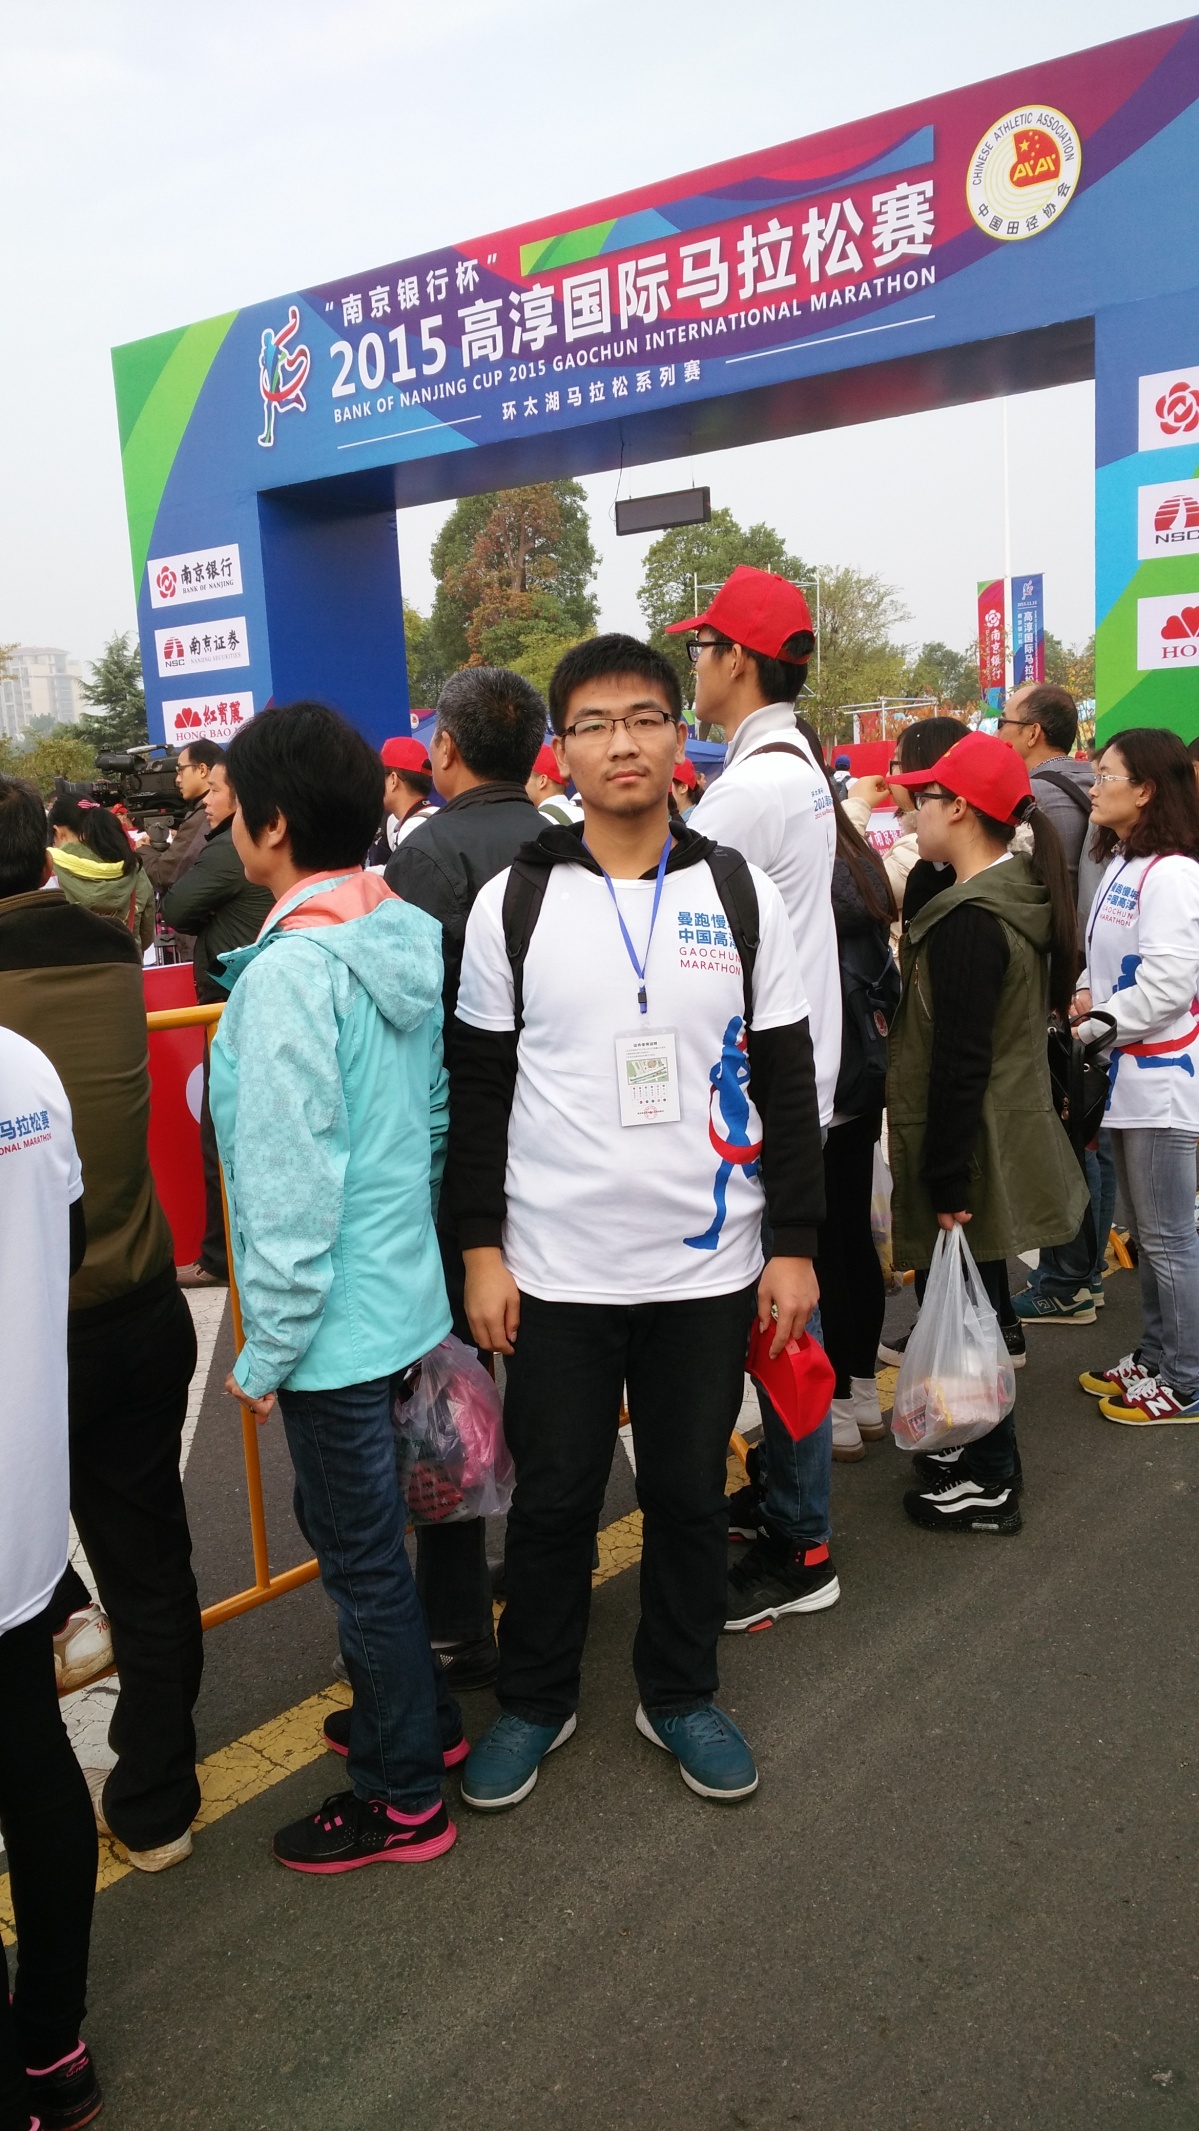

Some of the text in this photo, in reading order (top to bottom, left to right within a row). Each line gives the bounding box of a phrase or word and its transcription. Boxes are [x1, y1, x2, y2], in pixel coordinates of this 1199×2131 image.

[972, 112, 1075, 186] CHINESE ATHLETIC ASSOCIATION
[977, 182, 1071, 235] 中国田径协会
[330, 179, 936, 398] 2015 高淳国际马拉松赛
[334, 265, 936, 423] BANK OF NANJING CUP 2015 GAOCHUN INTERNATIONAL MARATHON
[502, 359, 701, 421] 环太湖马拉松系列赛
[1155, 529, 1199, 545] NSC
[181, 557, 233, 585] 南京银行
[182, 585, 198, 594] BANK
[208, 579, 234, 590] NANJING
[189, 629, 240, 656] 南京证券
[1161, 644, 1199, 660] HO
[165, 658, 185, 668] NSC
[176, 730, 206, 741] HONG
[210, 727, 231, 738] BAO
[678, 911, 732, 930] 曼跑慢
[679, 946, 741, 963] GAOCHUN
[680, 959, 741, 976] MARATHON
[0, 1109, 50, 1140] 马拉松赛
[1145, 1395, 1173, 1417] N
